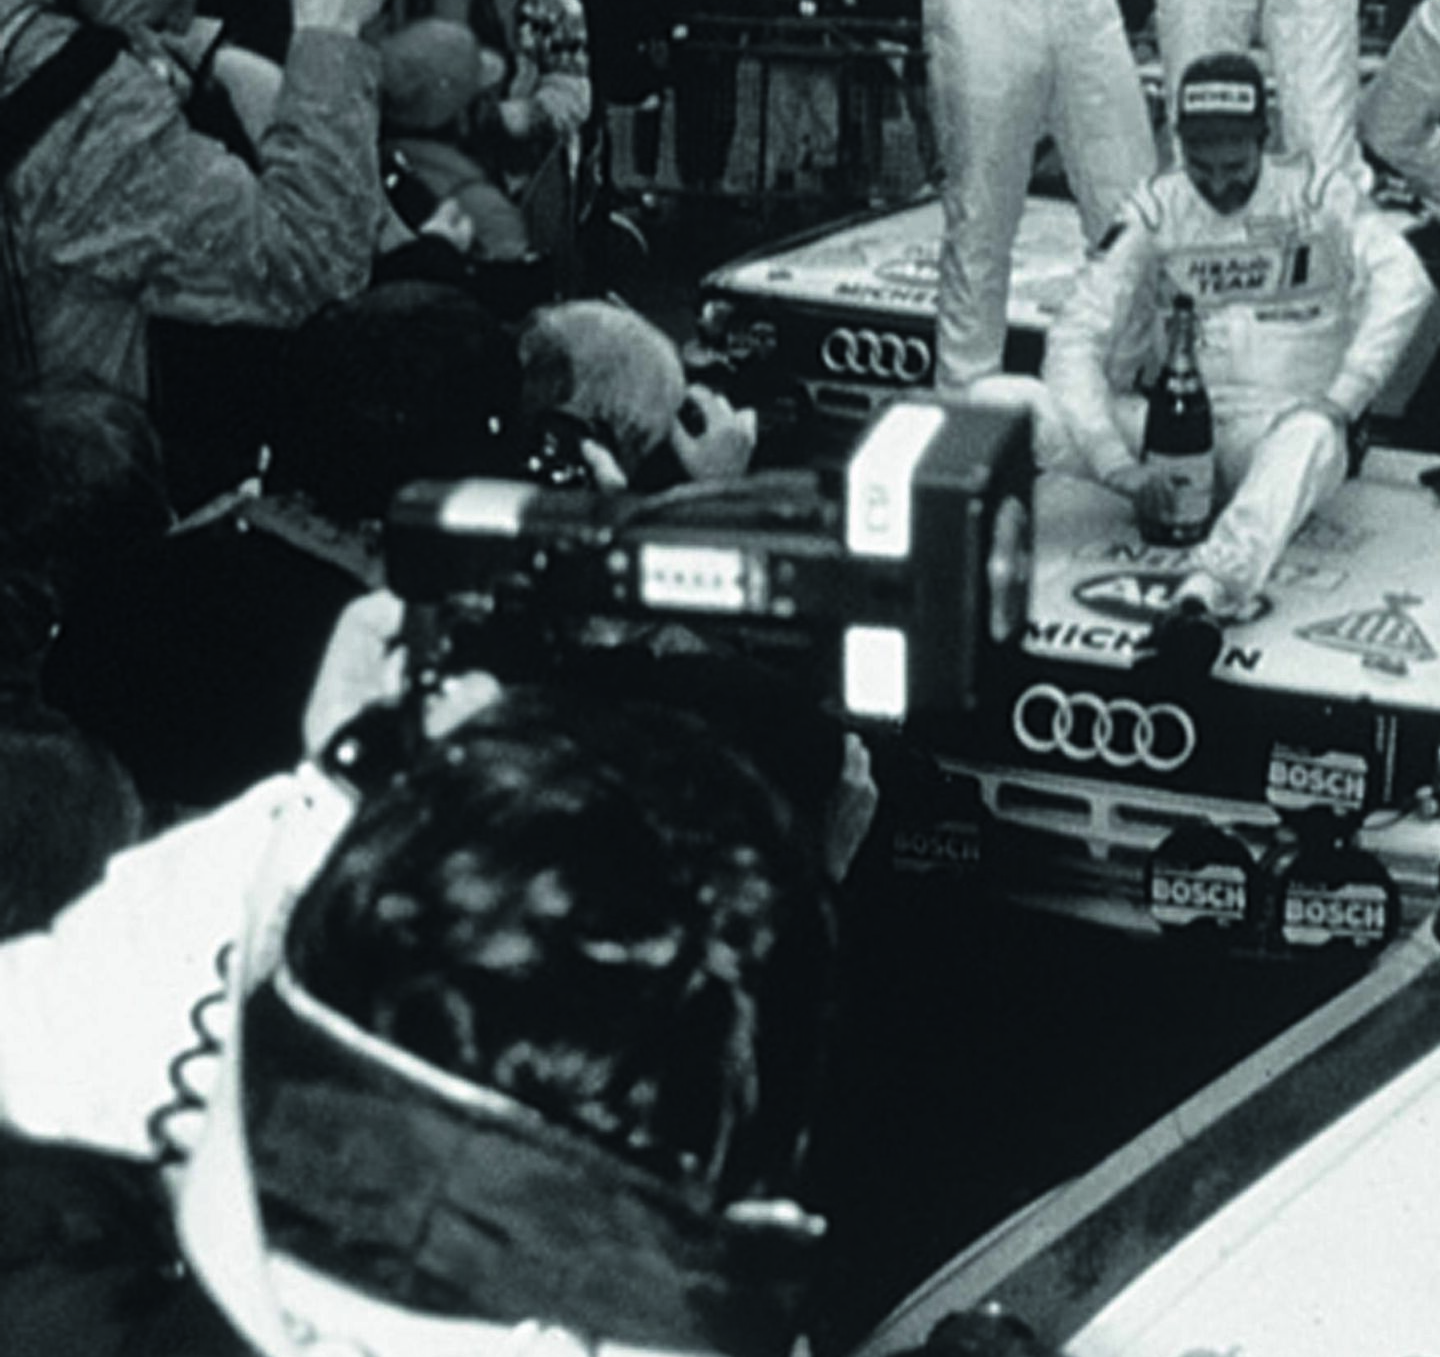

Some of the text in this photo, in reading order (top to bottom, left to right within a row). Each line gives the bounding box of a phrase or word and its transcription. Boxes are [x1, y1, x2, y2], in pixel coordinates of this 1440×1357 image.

[1269, 759, 1365, 800] BOSCH
[1152, 874, 1246, 909] BOSCH
[1285, 896, 1385, 929] BOSCH
